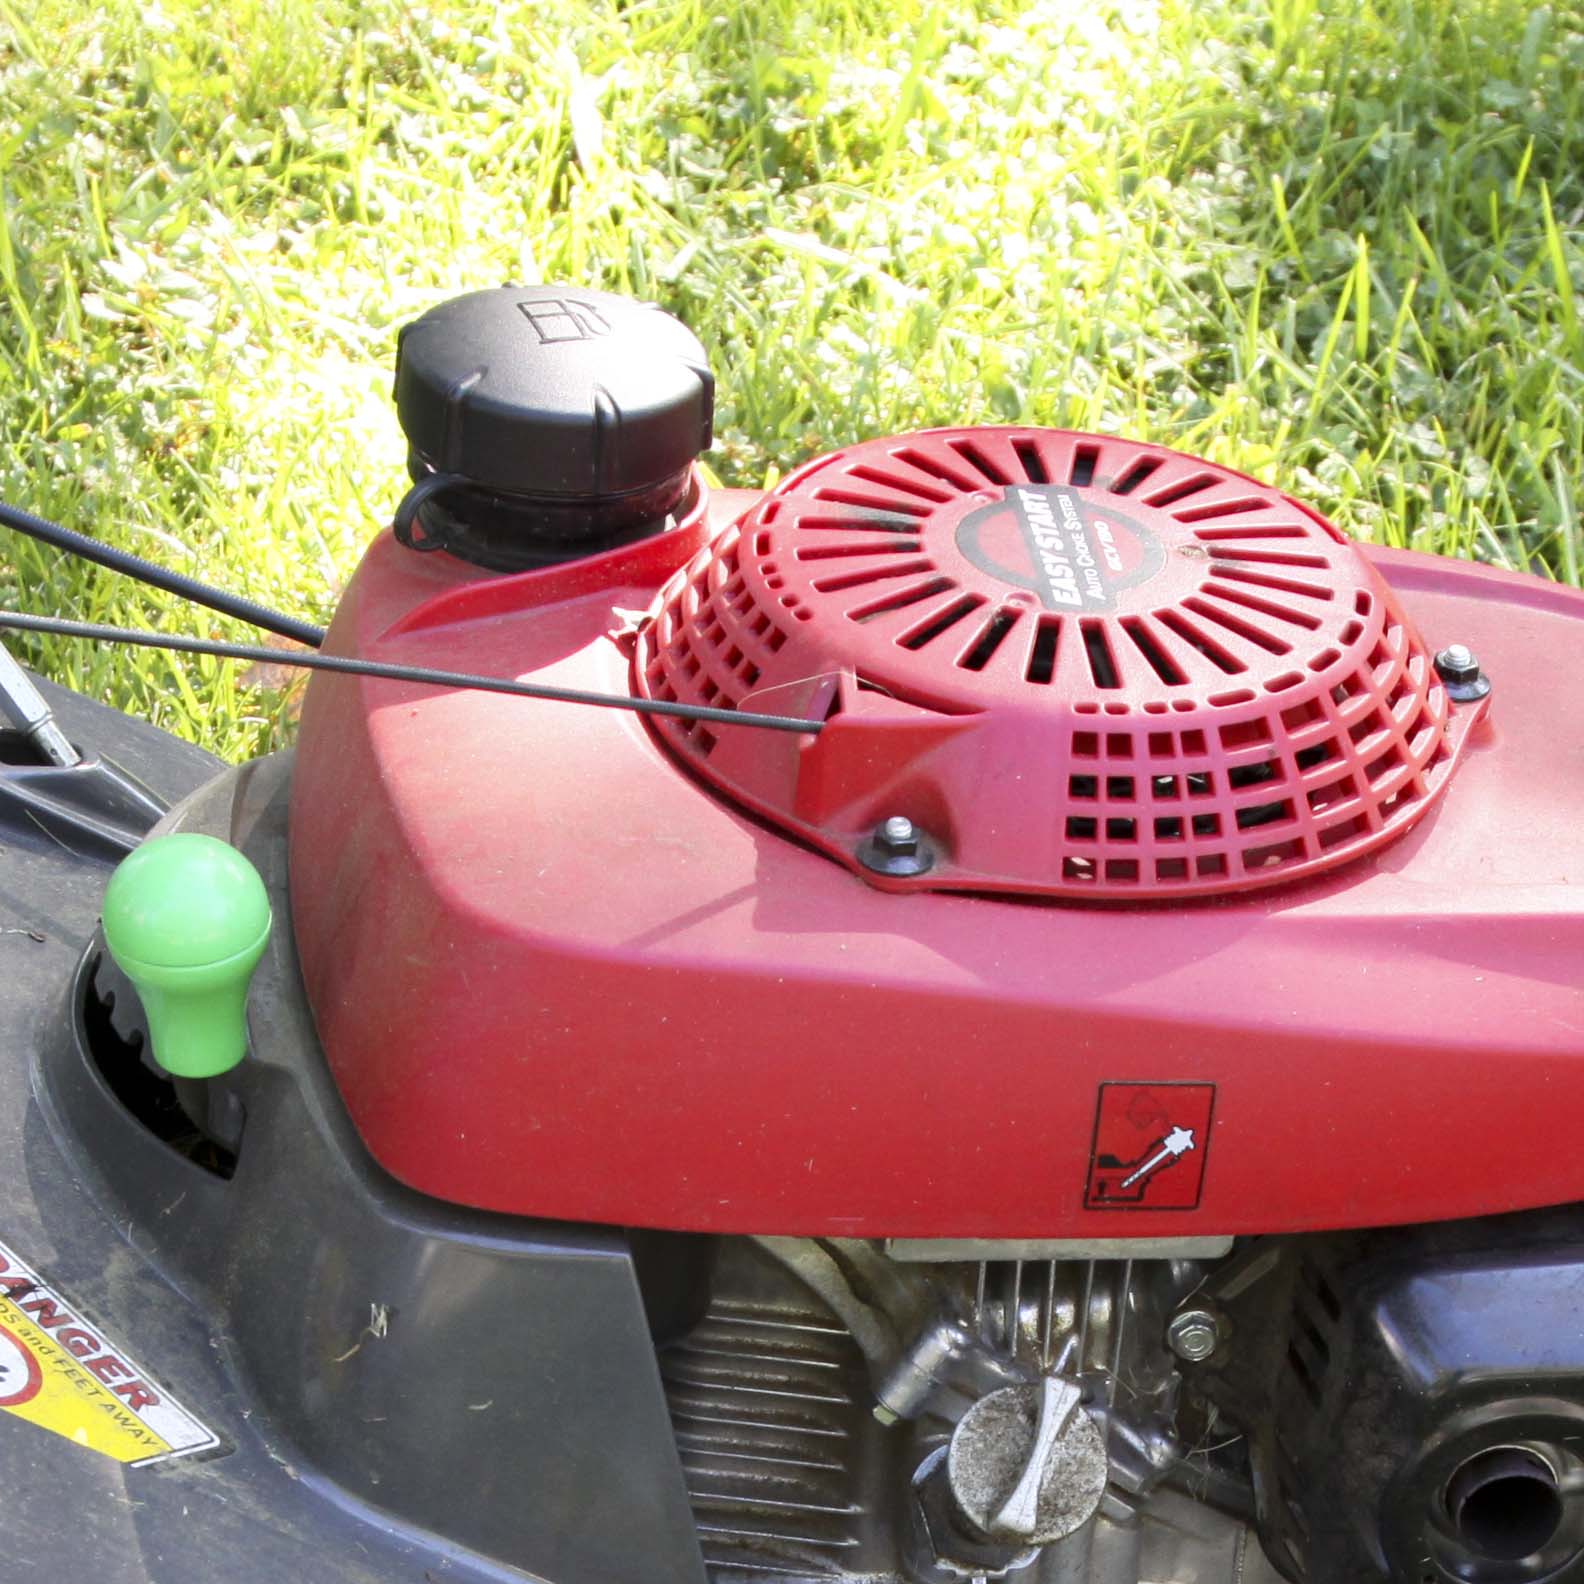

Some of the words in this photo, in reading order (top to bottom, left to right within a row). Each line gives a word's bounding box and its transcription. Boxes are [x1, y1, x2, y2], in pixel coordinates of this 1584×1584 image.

[1017, 488, 1065, 551] START
[1039, 549, 1083, 606] EASY
[19, 1326, 56, 1357] and
[53, 1356, 103, 1399] FEET
[99, 1402, 162, 1449] AWAY
